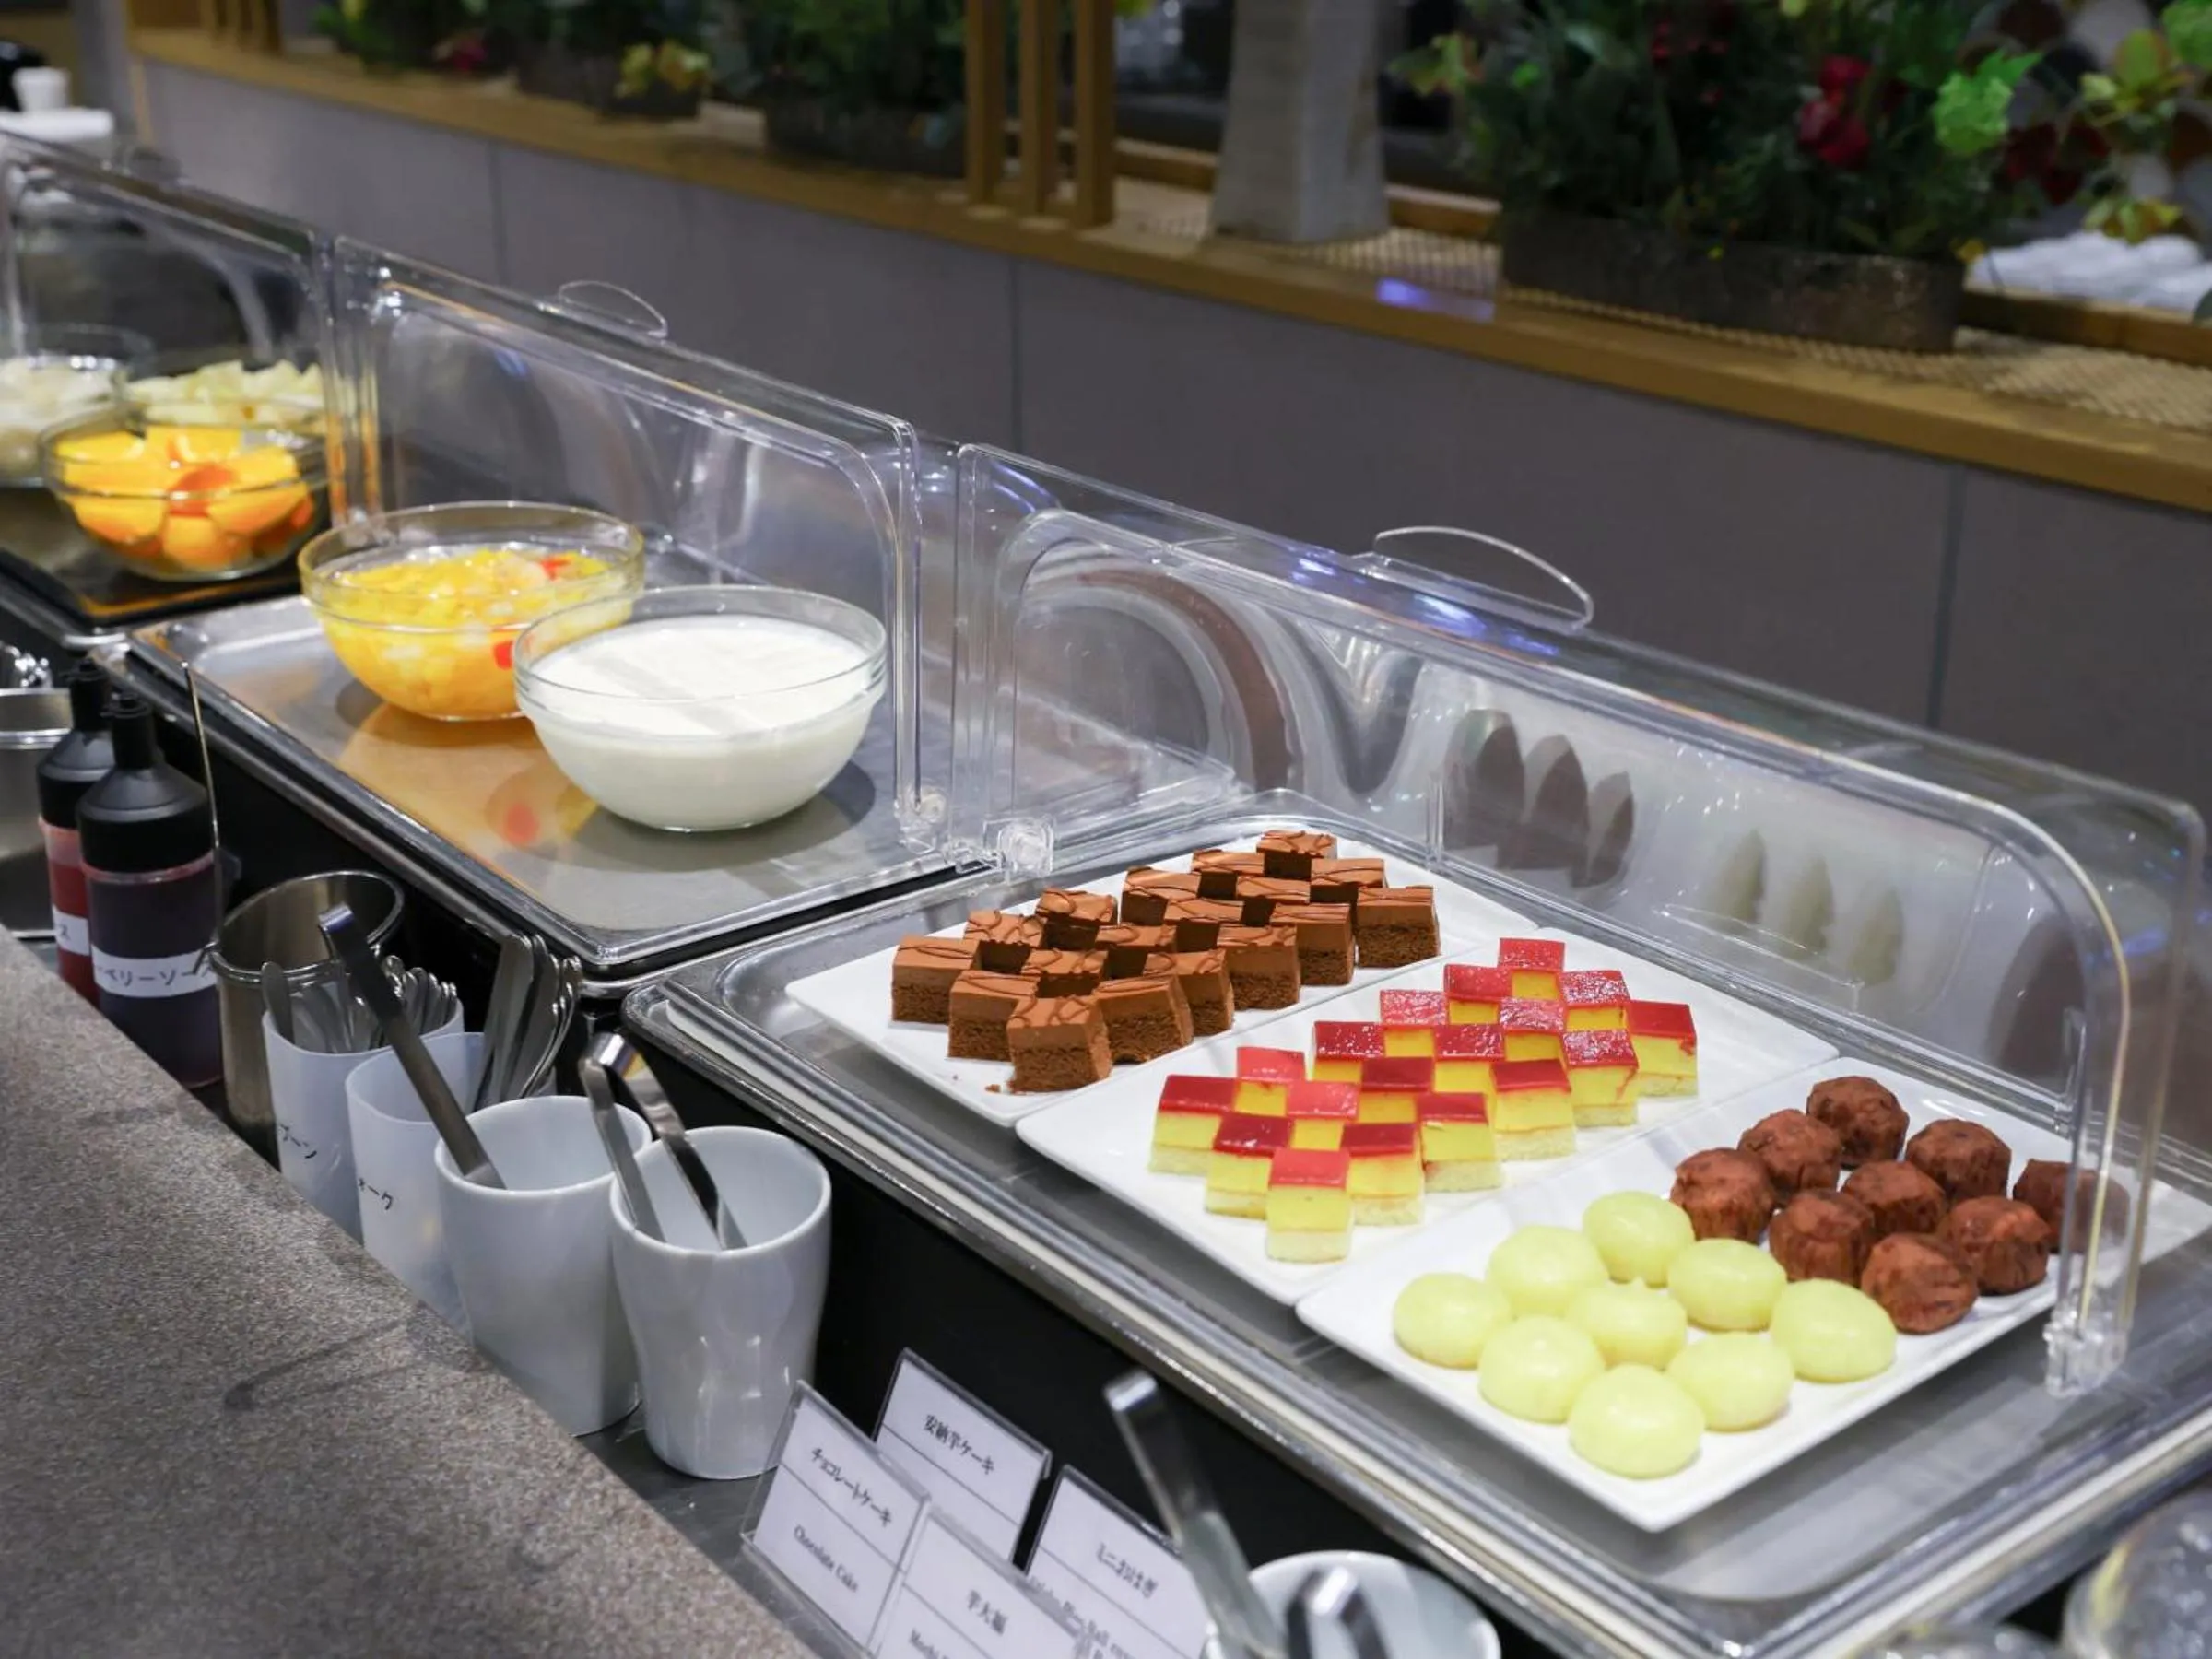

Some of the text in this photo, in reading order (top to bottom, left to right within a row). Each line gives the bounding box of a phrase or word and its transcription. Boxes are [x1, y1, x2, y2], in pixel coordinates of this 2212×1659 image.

[811, 1447, 893, 1528] チョコレートケーキ
